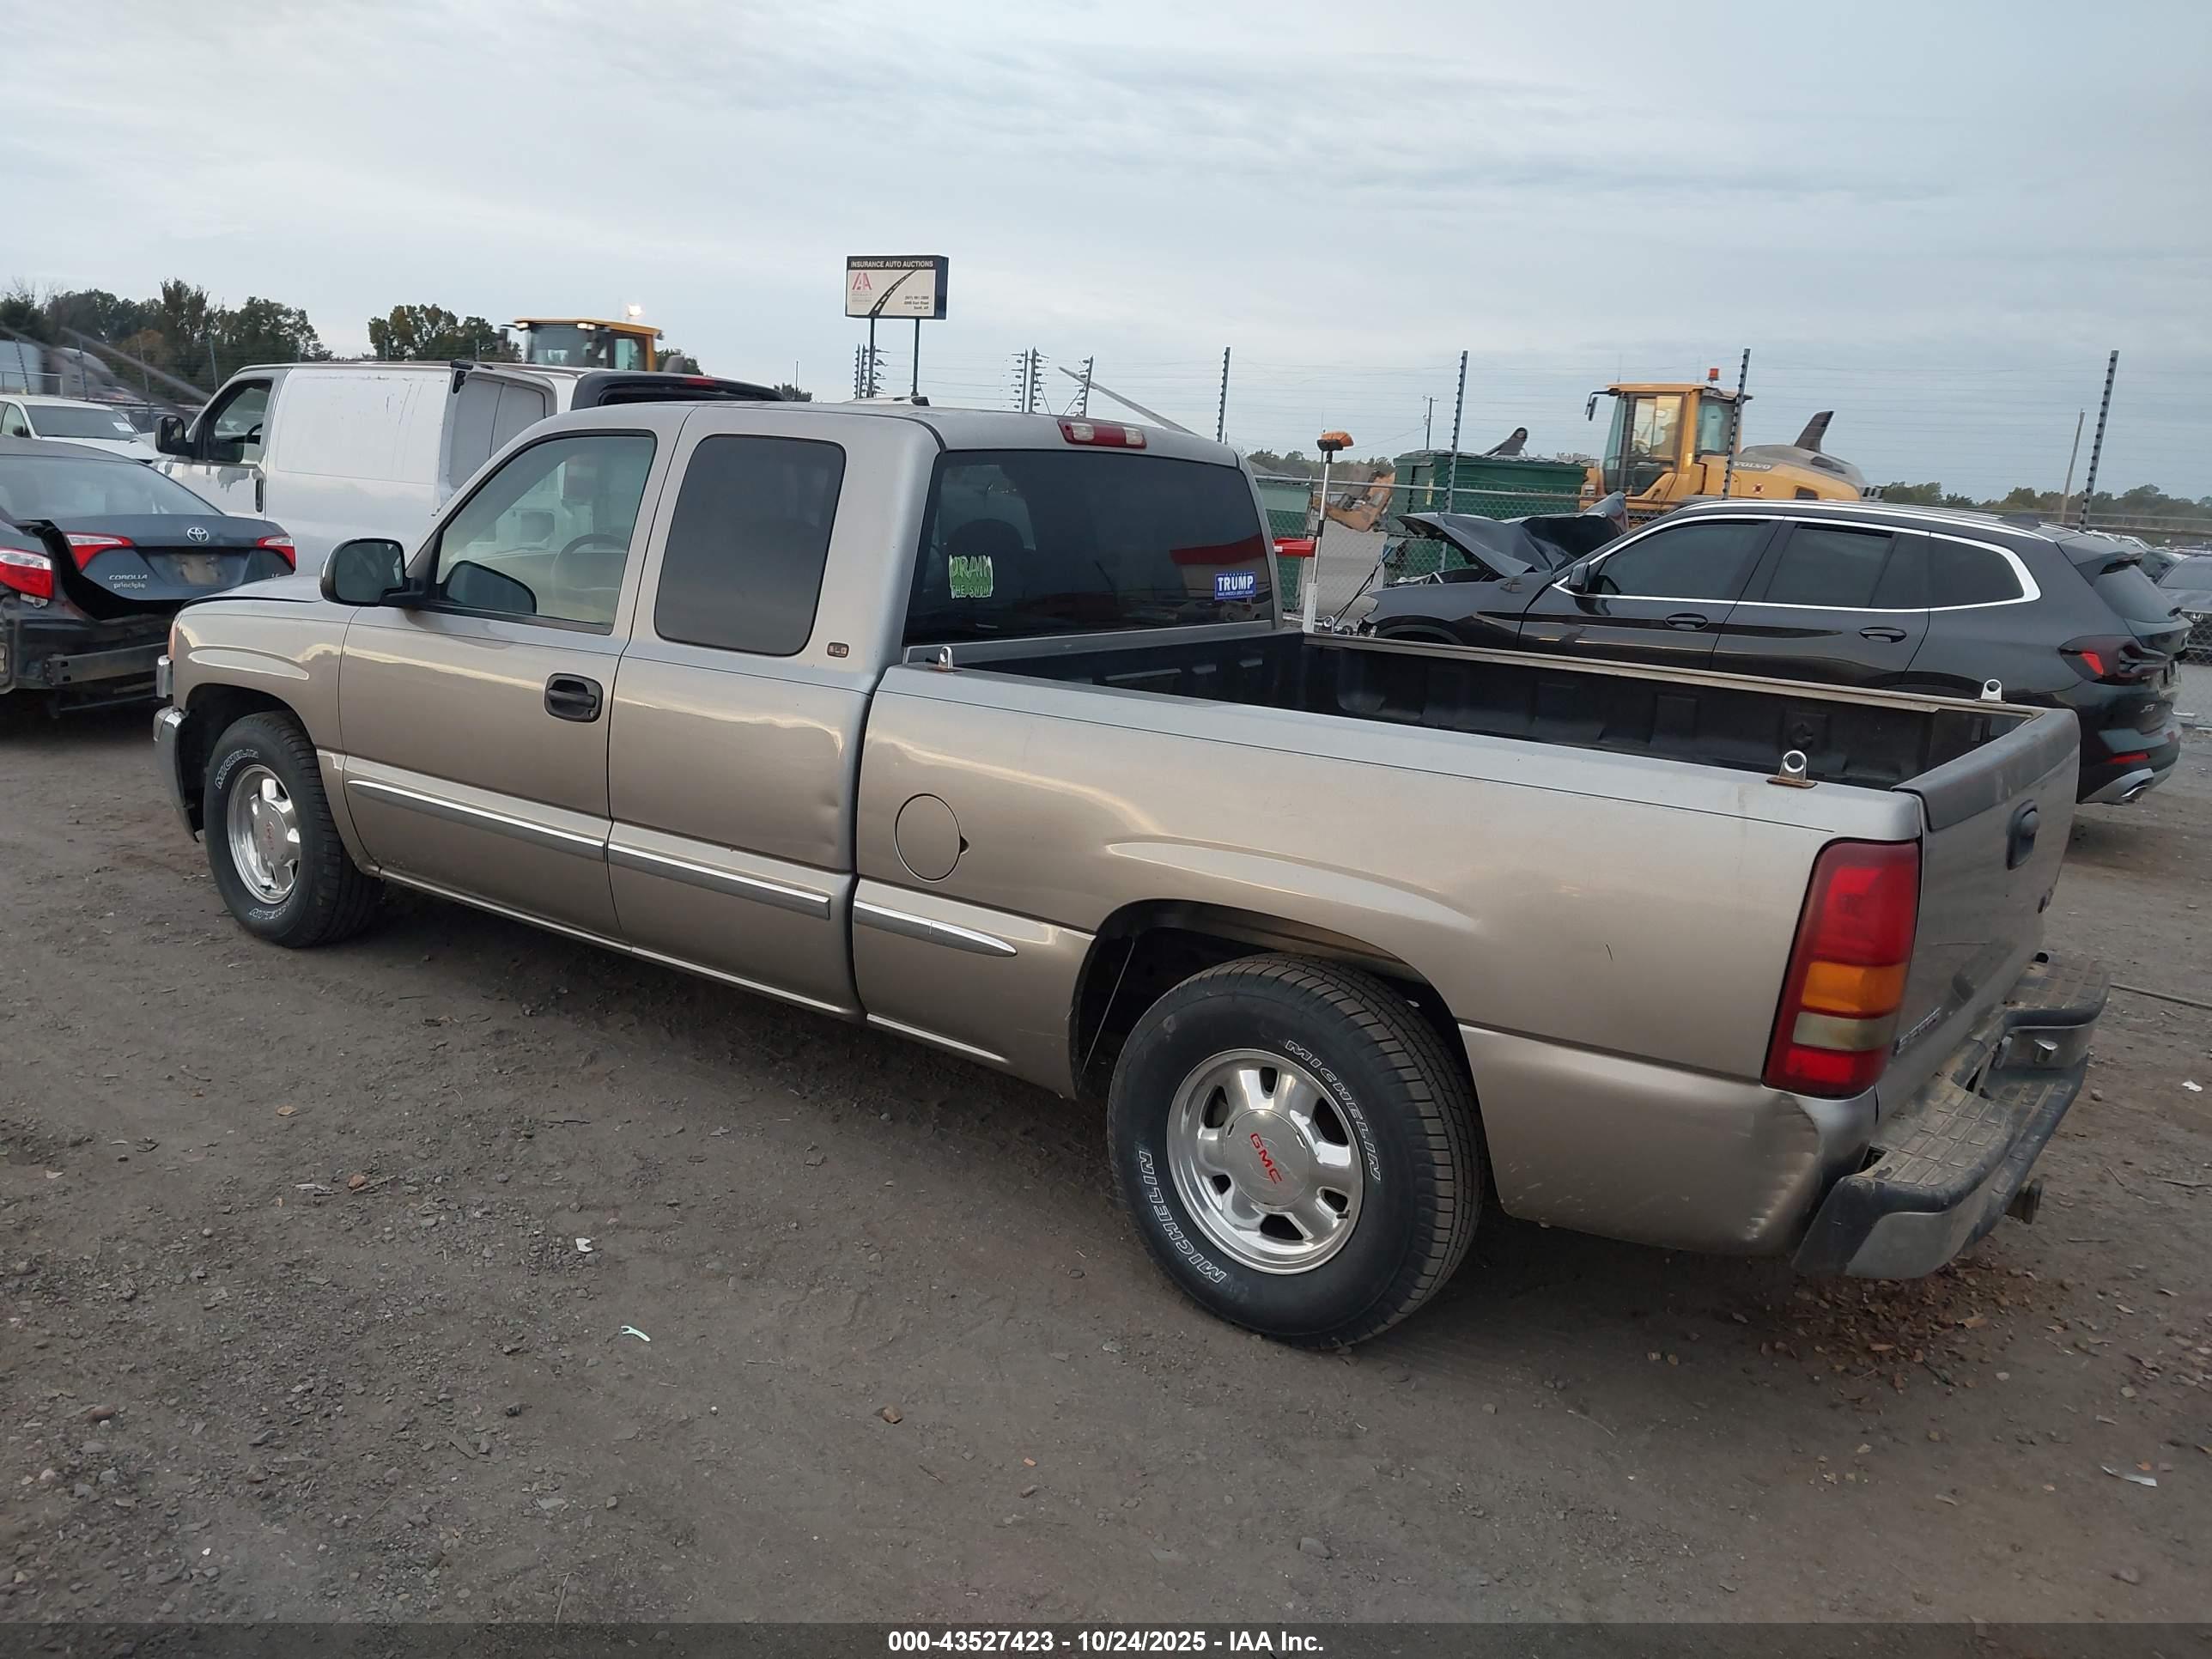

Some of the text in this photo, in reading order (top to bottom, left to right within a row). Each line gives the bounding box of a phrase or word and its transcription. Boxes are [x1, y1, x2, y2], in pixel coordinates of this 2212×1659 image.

[1218, 575, 1254, 592] TRUMP
[215, 749, 259, 790] MICHELIN
[1285, 1039, 1382, 1182] MICHELIN
[1249, 1133, 1283, 1185] GMC
[1139, 1151, 1227, 1284] MICHELIN
